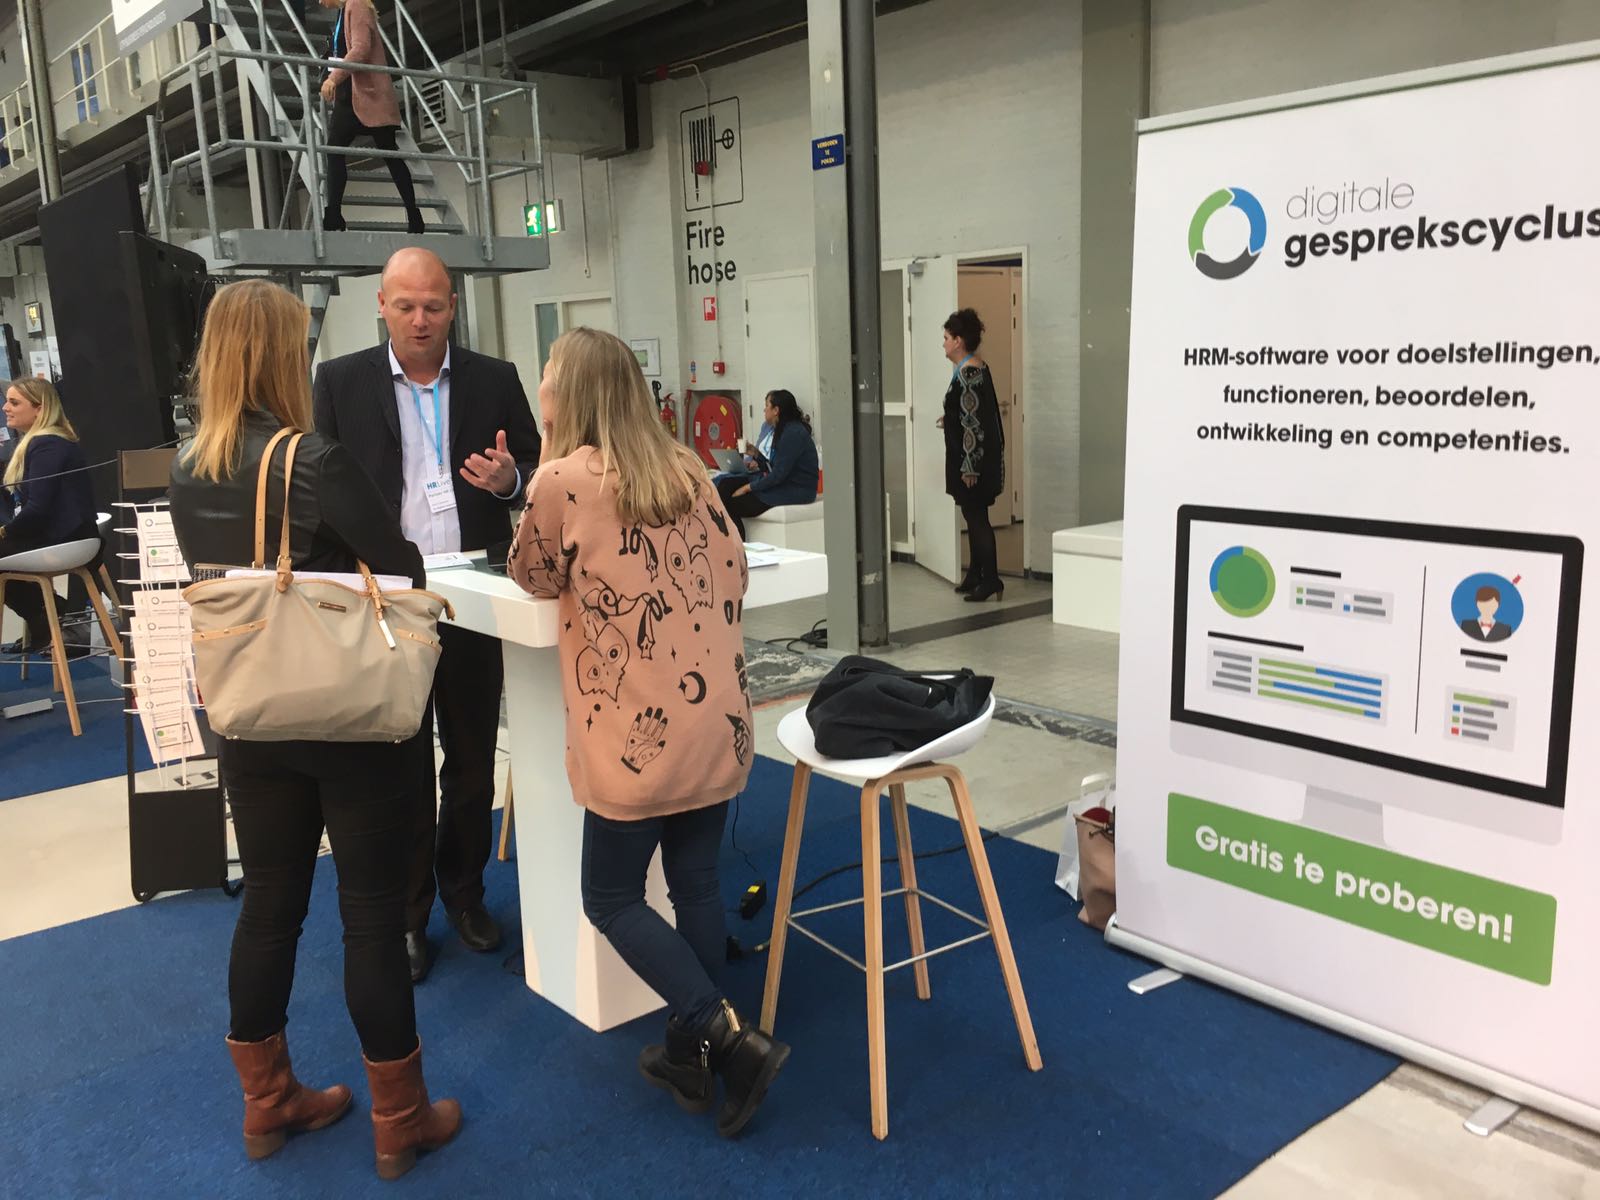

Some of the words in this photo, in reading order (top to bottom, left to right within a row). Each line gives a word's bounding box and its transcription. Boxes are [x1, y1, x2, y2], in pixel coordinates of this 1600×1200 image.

[1286, 177, 1415, 225] digitale
[686, 219, 725, 251] Fire
[1284, 203, 1600, 269] gesprekscyclus
[687, 254, 737, 285] hose
[1184, 346, 1329, 366] HRM-software
[1336, 348, 1390, 365] voor
[1396, 341, 1600, 370] doelstellingen,
[1223, 384, 1369, 407] functioneren,
[1375, 385, 1536, 410] beoordelen,
[1196, 422, 1333, 450] ontwikkeling
[1340, 429, 1369, 446] en
[1377, 429, 1570, 454] competenties.
[1195, 825, 1284, 874] Gratis
[1293, 852, 1325, 885] te
[1334, 869, 1513, 944] proberen!
